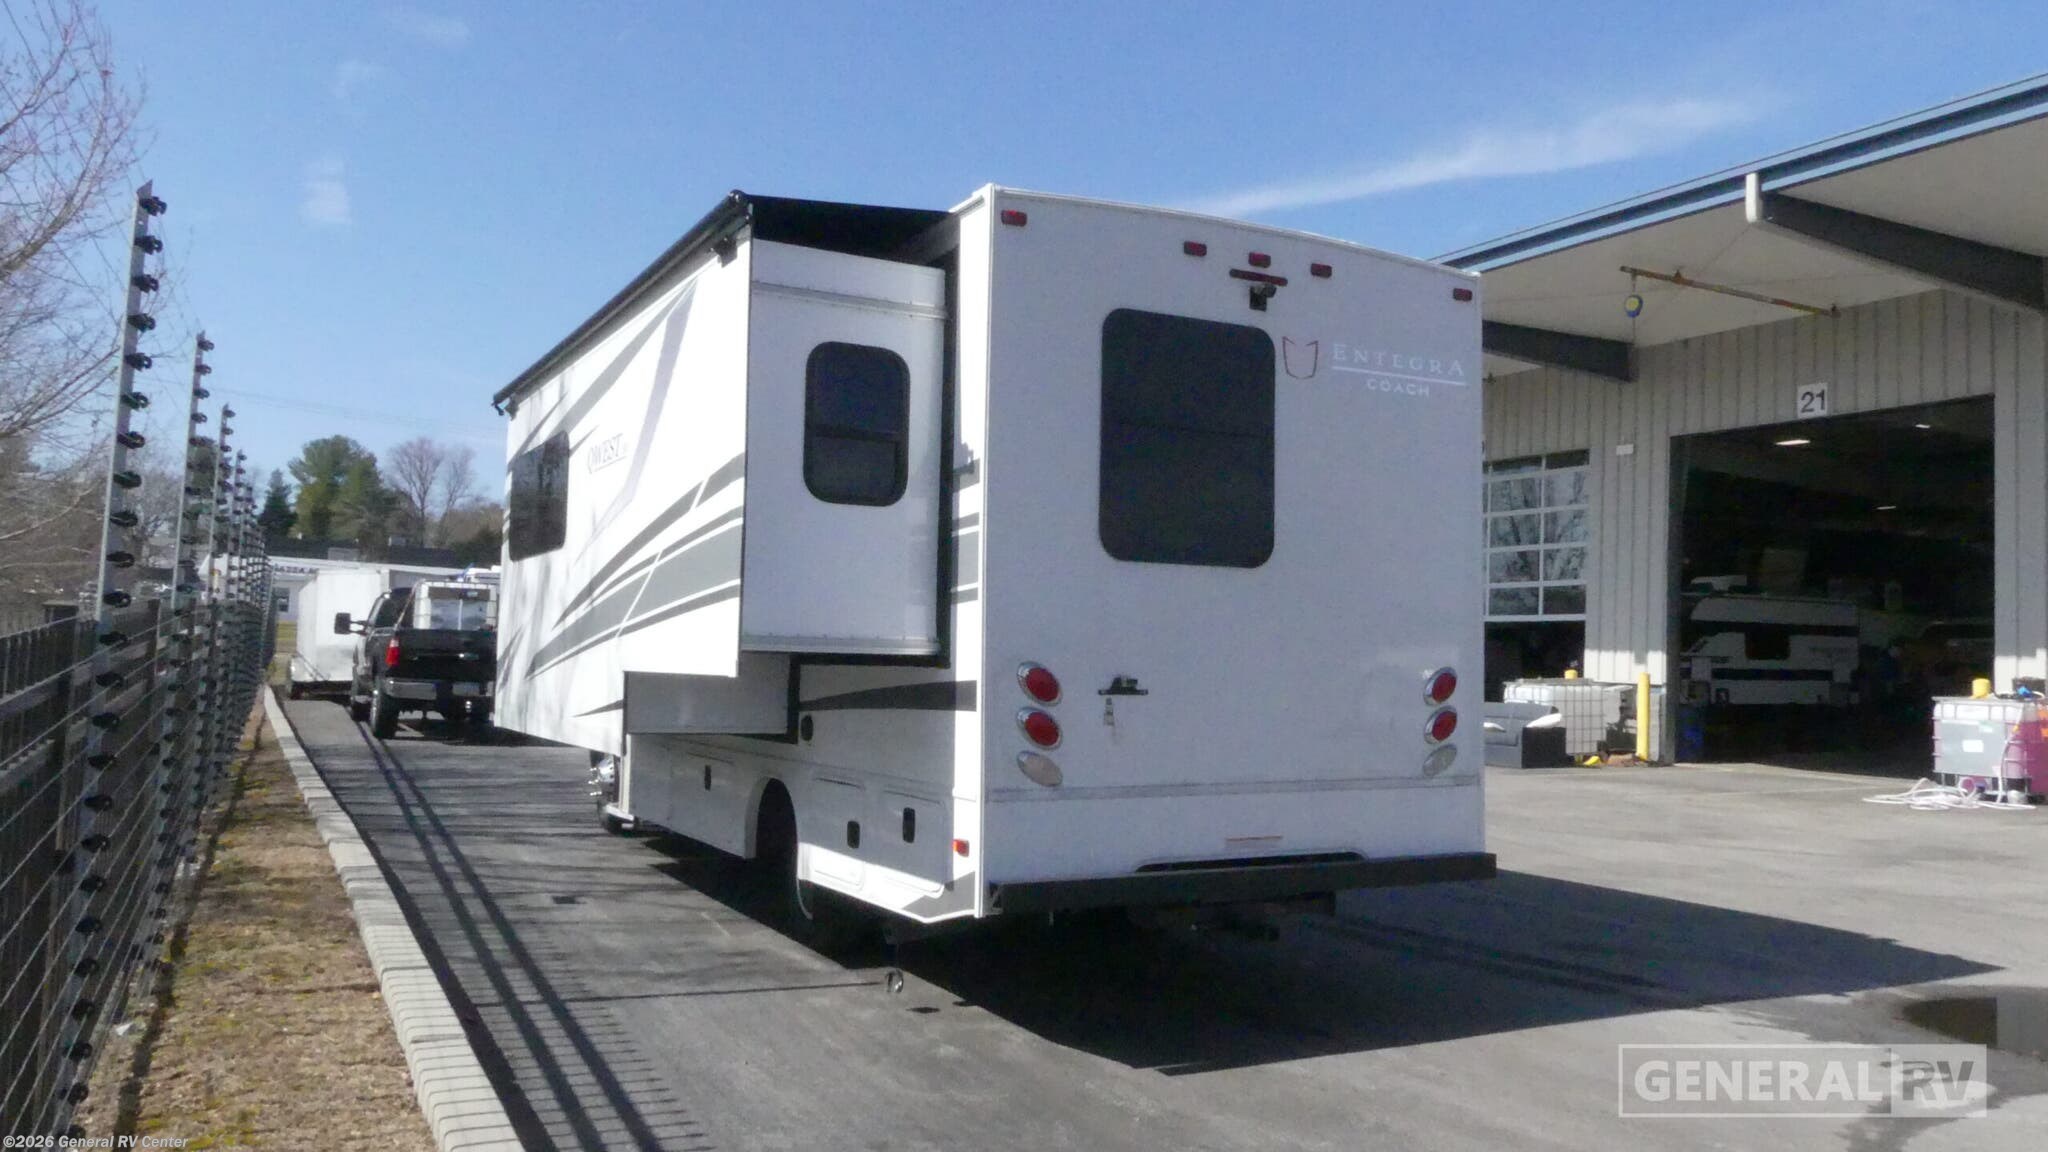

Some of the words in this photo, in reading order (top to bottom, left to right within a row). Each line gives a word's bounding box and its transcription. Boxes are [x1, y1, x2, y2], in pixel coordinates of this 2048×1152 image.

[1332, 343, 1465, 377] ENTEGRA
[1366, 377, 1430, 397] COACH
[1800, 389, 1825, 413] 21
